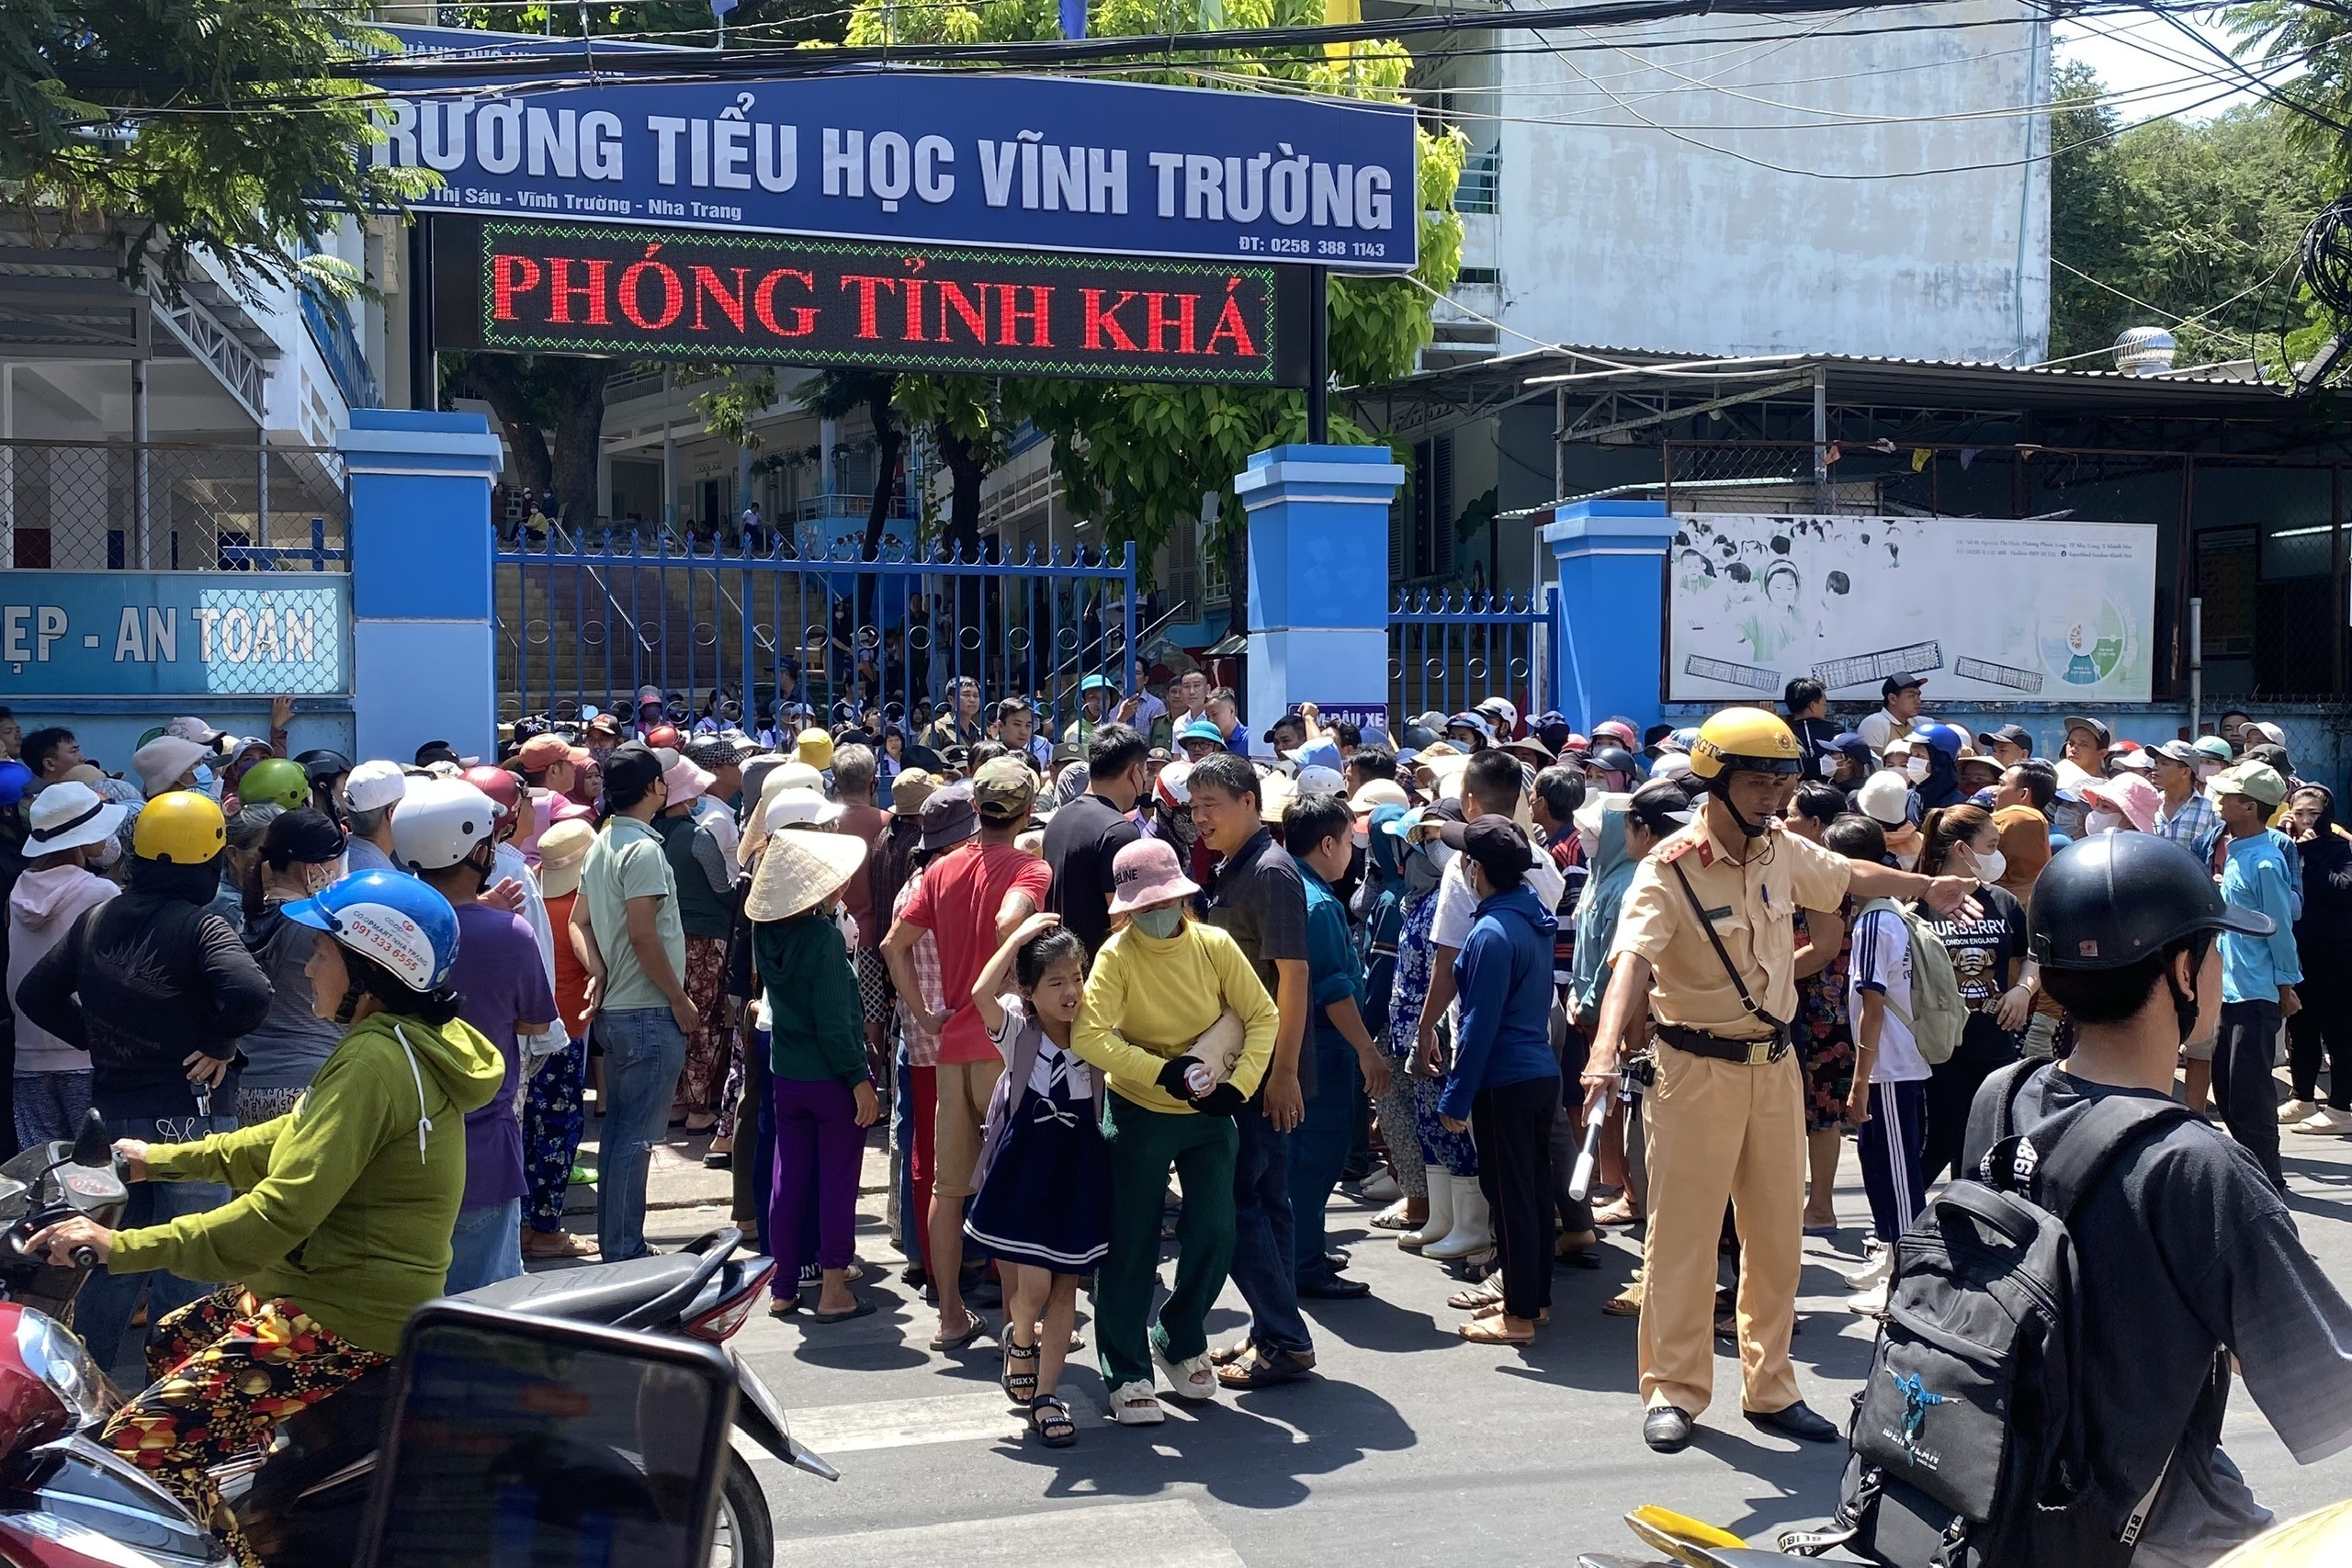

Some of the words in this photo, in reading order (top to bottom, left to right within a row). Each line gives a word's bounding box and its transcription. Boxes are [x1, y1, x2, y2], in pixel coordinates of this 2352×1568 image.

[371, 93, 624, 183] RƯỜNG
[647, 91, 797, 193] TIỂU
[821, 128, 956, 214] HỌC
[977, 130, 1129, 216] VĨNH
[1148, 142, 1393, 231] TRƯỜNG
[465, 187, 502, 205] Sáu
[517, 189, 559, 210] Vĩnh
[564, 193, 630, 215] Trường
[648, 199, 684, 218] Nha
[690, 201, 742, 221] Trang
[1238, 235, 1265, 252] ĐT:
[1270, 237, 1310, 254] 0258
[1317, 239, 1347, 255] 388
[1351, 241, 1385, 257] 1143
[492, 243, 821, 338] PHÓNG
[840, 257, 1056, 348] TỈNH
[1078, 277, 1265, 356] KHÁ
[0, 604, 69, 675] ẸP
[113, 605, 177, 663] AN
[191, 592, 314, 663] TOÀN
[1364, 712, 1385, 727] XE
[352, 920, 371, 937] 091
[371, 934, 392, 952] 333
[392, 949, 419, 971] 6555
[1970, 937, 1999, 945] ENGLAND
[1011, 1348, 1032, 1357] RGXX
[1010, 1377, 1035, 1386] RGXX
